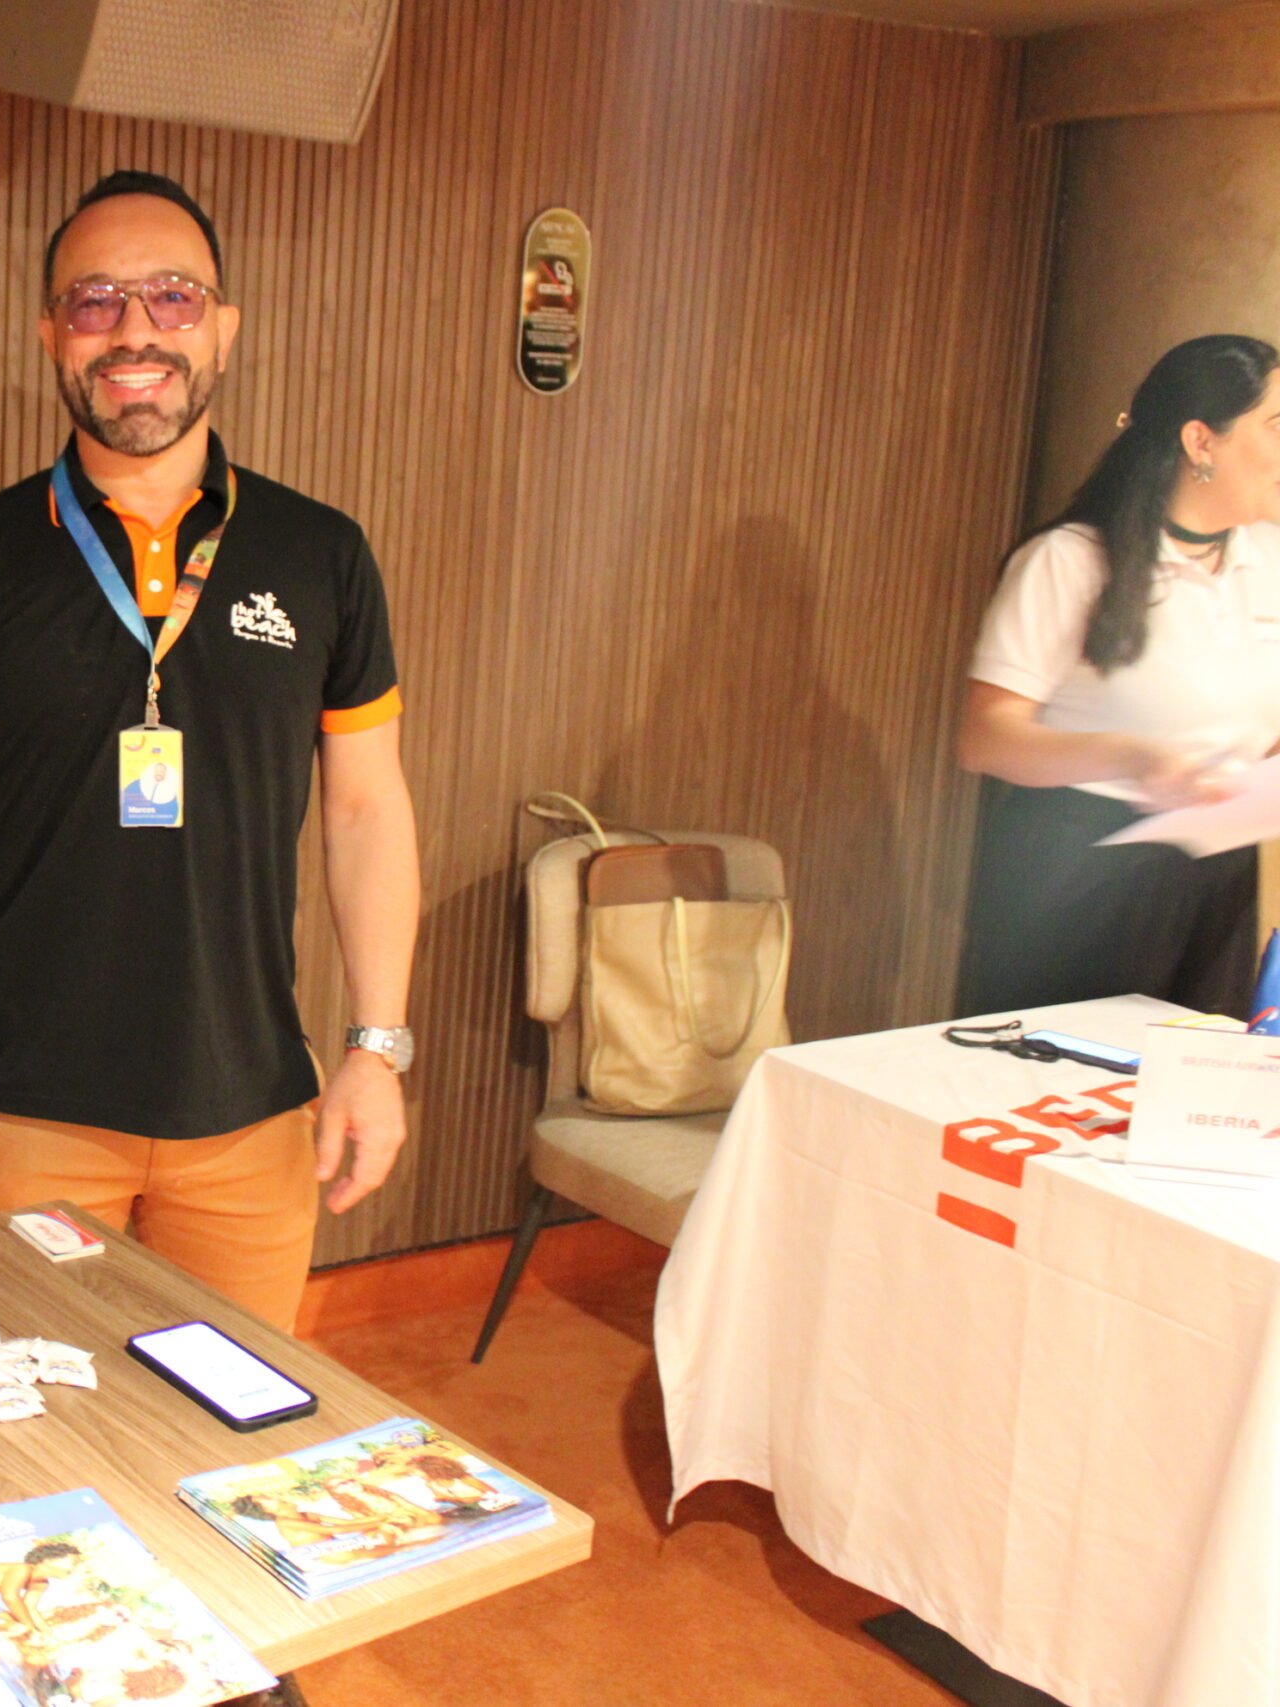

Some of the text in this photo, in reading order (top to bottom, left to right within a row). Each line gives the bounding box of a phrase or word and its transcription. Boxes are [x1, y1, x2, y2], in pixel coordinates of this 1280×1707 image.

[238, 601, 266, 619] hot
[230, 603, 297, 642] beach
[1187, 1112, 1261, 1130] IBERIA
